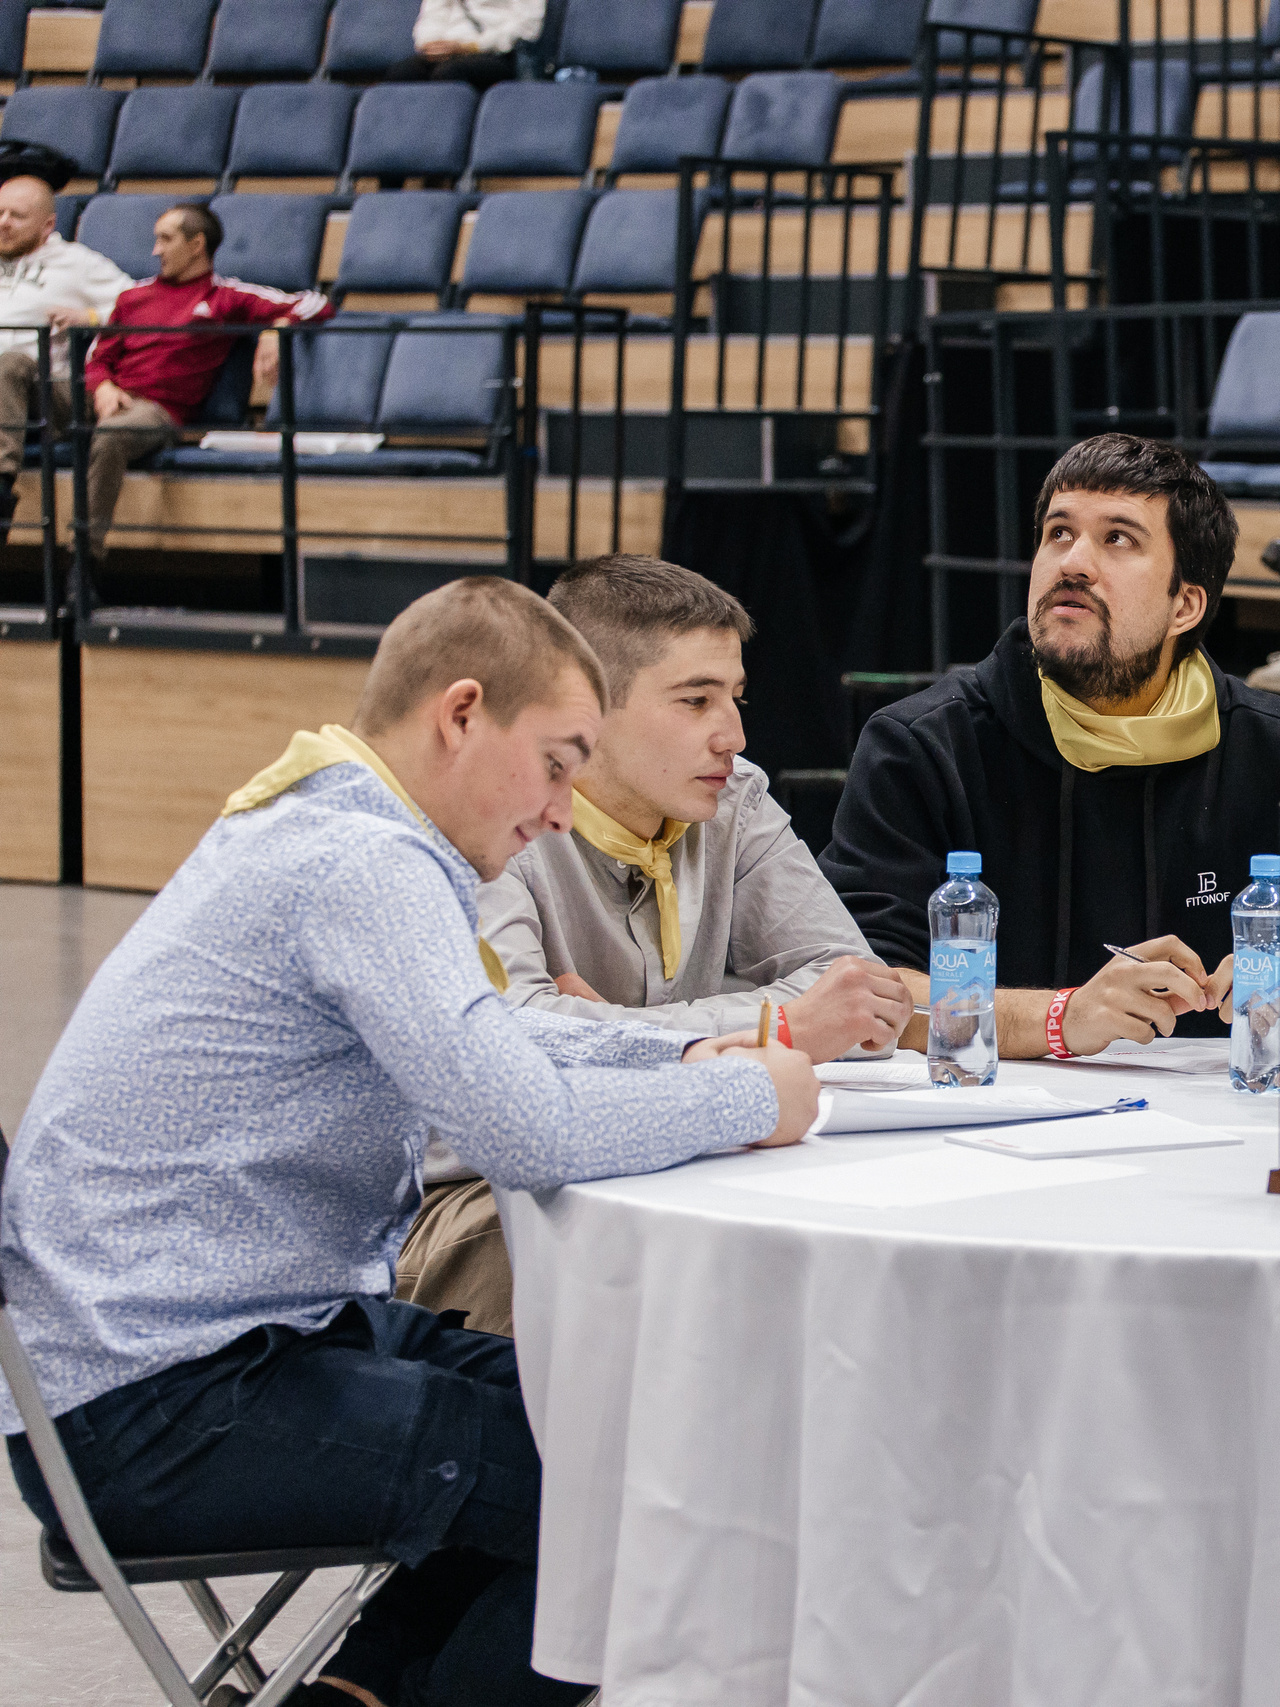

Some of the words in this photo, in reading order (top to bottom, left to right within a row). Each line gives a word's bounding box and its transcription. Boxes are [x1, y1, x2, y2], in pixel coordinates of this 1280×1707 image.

[1185, 891, 1231, 908] FITONOF
[931, 951, 969, 972] AQUA
[1234, 954, 1273, 975] AQUA
[1046, 990, 1071, 1055] ИГРОК
